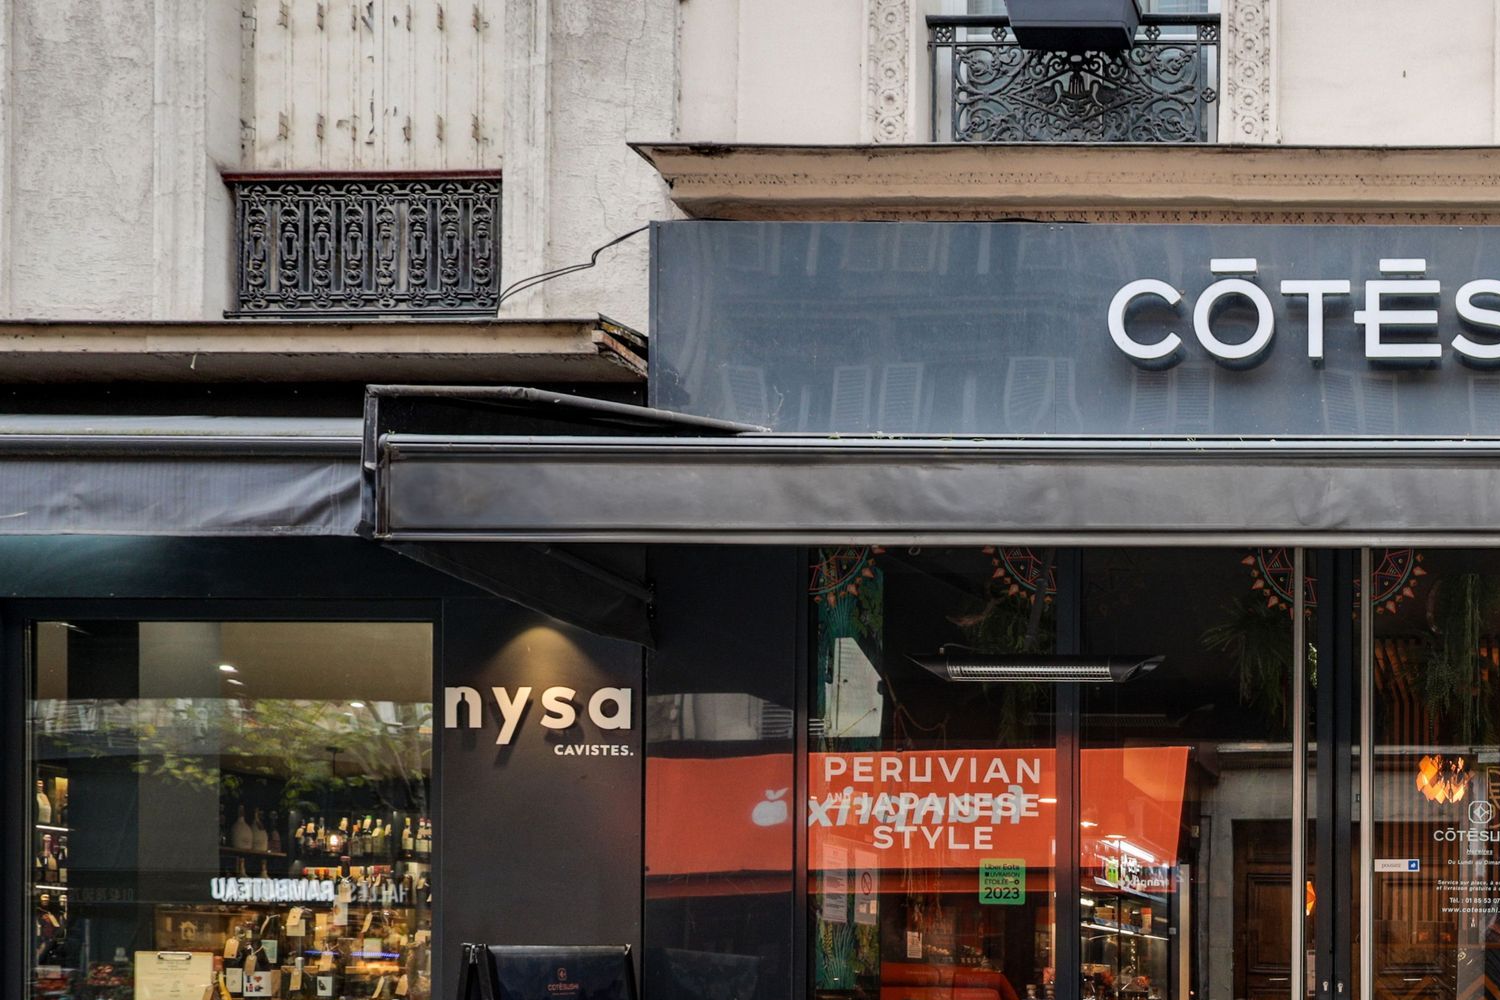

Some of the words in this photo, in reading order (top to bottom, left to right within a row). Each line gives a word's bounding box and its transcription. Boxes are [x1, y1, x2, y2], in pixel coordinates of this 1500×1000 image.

[444, 686, 632, 745] nysa
[554, 744, 634, 756] CAVISTES.
[825, 757, 1041, 783] PERUVIAN
[855, 792, 1039, 817] JAPANESE
[873, 826, 993, 850] STYLE
[984, 887, 1020, 899] 2023
